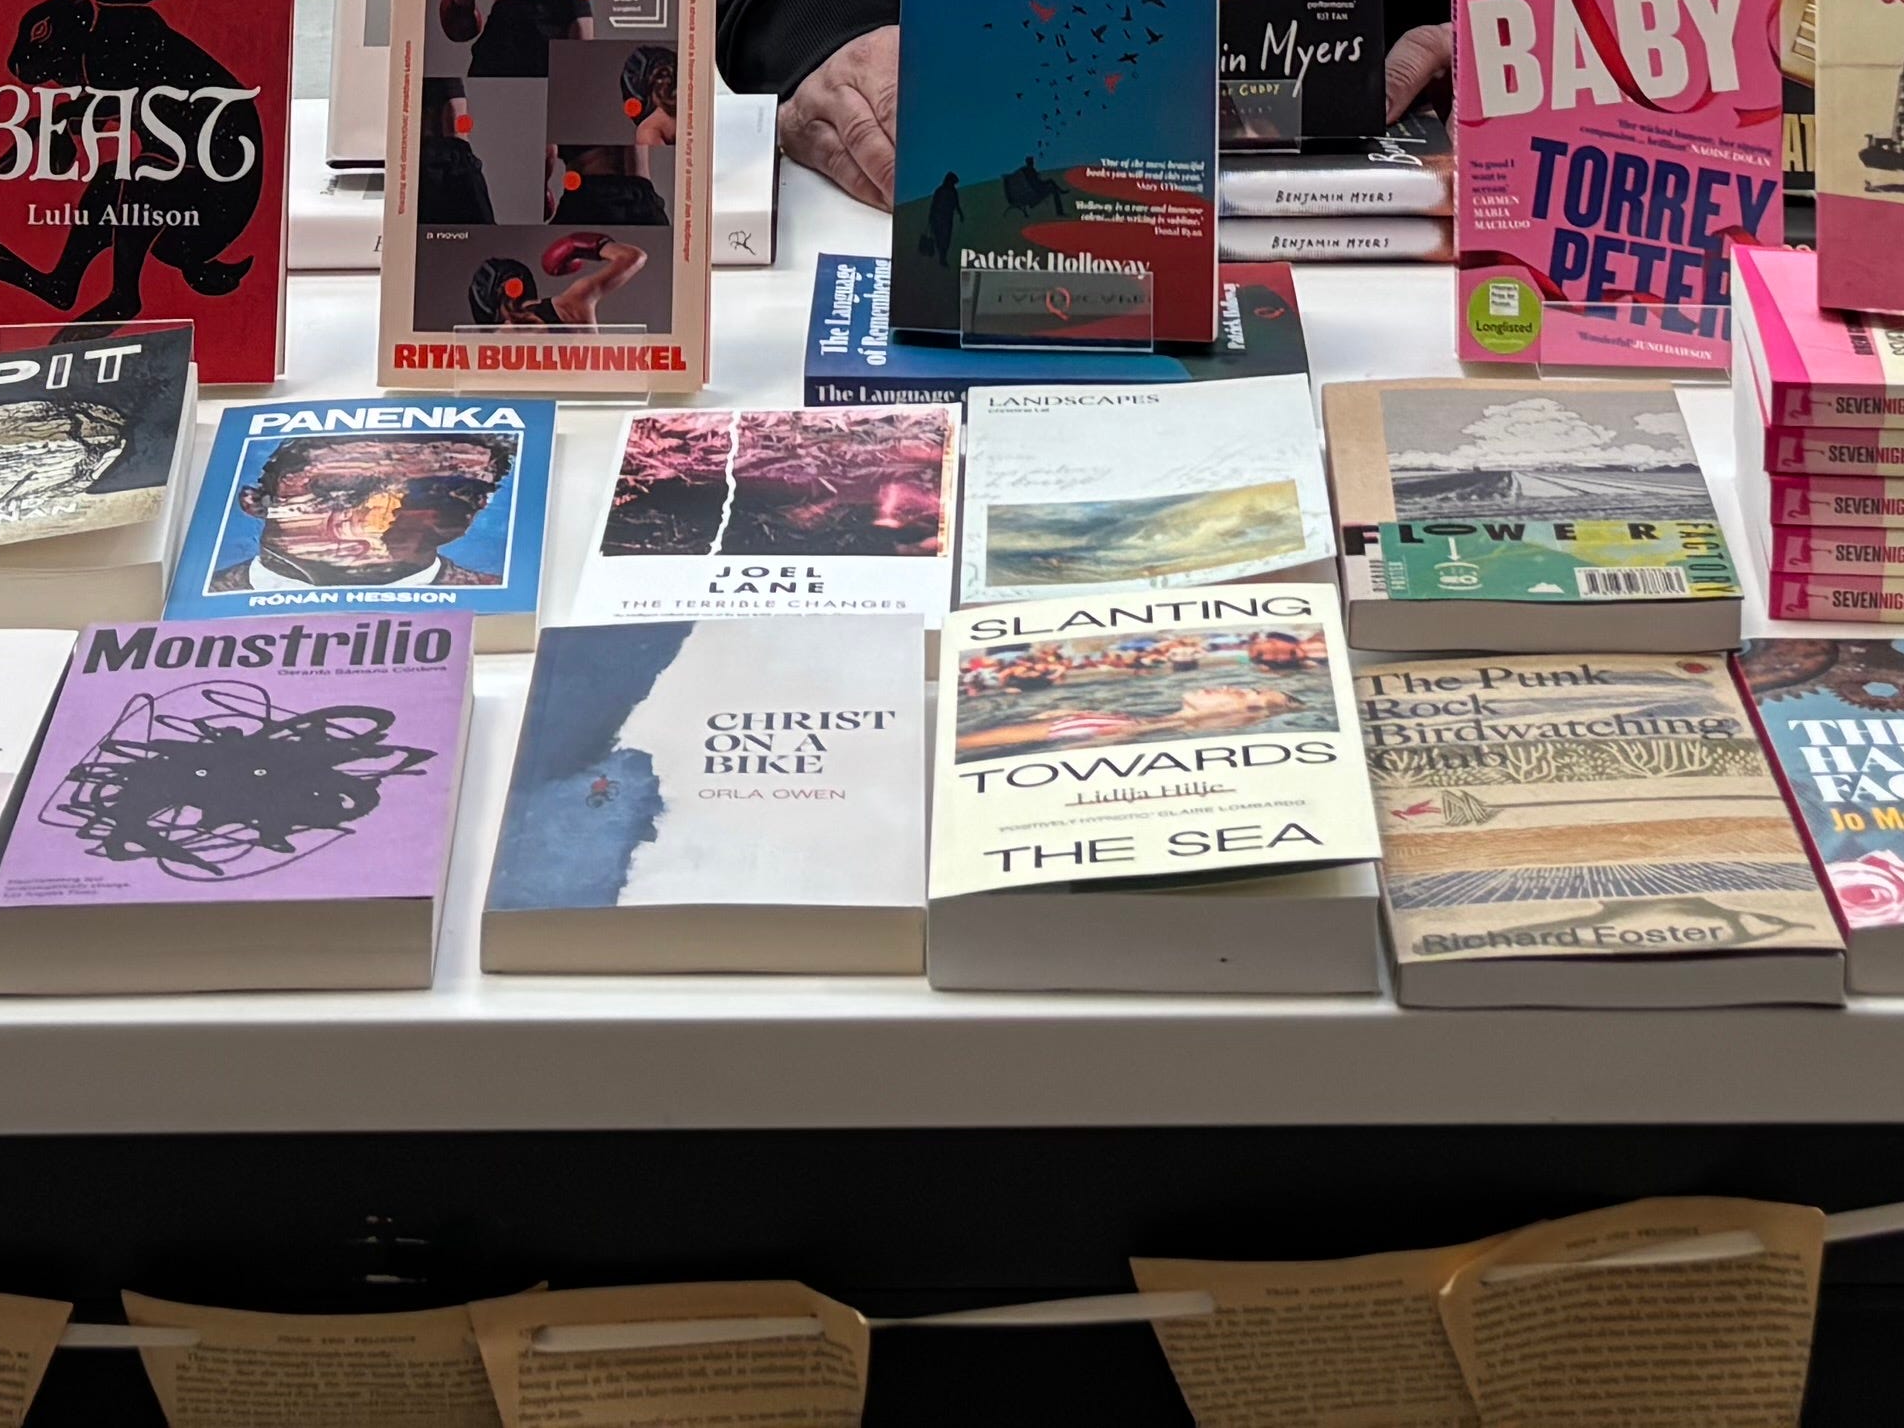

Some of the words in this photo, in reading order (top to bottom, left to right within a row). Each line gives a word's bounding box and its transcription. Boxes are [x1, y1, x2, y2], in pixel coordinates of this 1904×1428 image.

[1261, 20, 1363, 97] Myers
[1530, 137, 1779, 224] TORREY
[1276, 191, 1343, 204] BENJAMIN
[1350, 193, 1393, 202] MYERS
[27, 204, 89, 227] Lulu
[99, 203, 200, 227] Allison
[960, 248, 1040, 270] Patrick
[1047, 251, 1149, 276] Holloway
[1475, 318, 1533, 334] Longlisted
[394, 344, 470, 370] RITA
[477, 346, 686, 371] BULLWINKEL
[988, 395, 1159, 407] LANDSCAPES
[249, 406, 525, 433] PANENKA
[715, 566, 823, 580] JOEL
[346, 592, 456, 605] HESSION
[709, 581, 825, 594] LANE
[969, 597, 1313, 641] SLANTING
[73, 619, 451, 675] Monstrilio
[1361, 672, 1474, 697] The
[1476, 664, 1610, 691] Punk
[1361, 696, 1500, 720] Rock
[706, 710, 896, 732] CHRIST
[1363, 712, 1733, 746] Birdwatching
[705, 733, 774, 753] ON
[792, 733, 829, 753] A
[702, 755, 824, 776] BIKE
[958, 742, 1337, 795] TOWARDS
[698, 789, 764, 801] ORLA
[772, 788, 847, 800] OWEN
[1831, 809, 1863, 834] Jo
[984, 837, 1137, 872] THE
[1166, 824, 1326, 852] SEA
[1421, 928, 1581, 954] Richard
[1594, 921, 1725, 947] Foster
